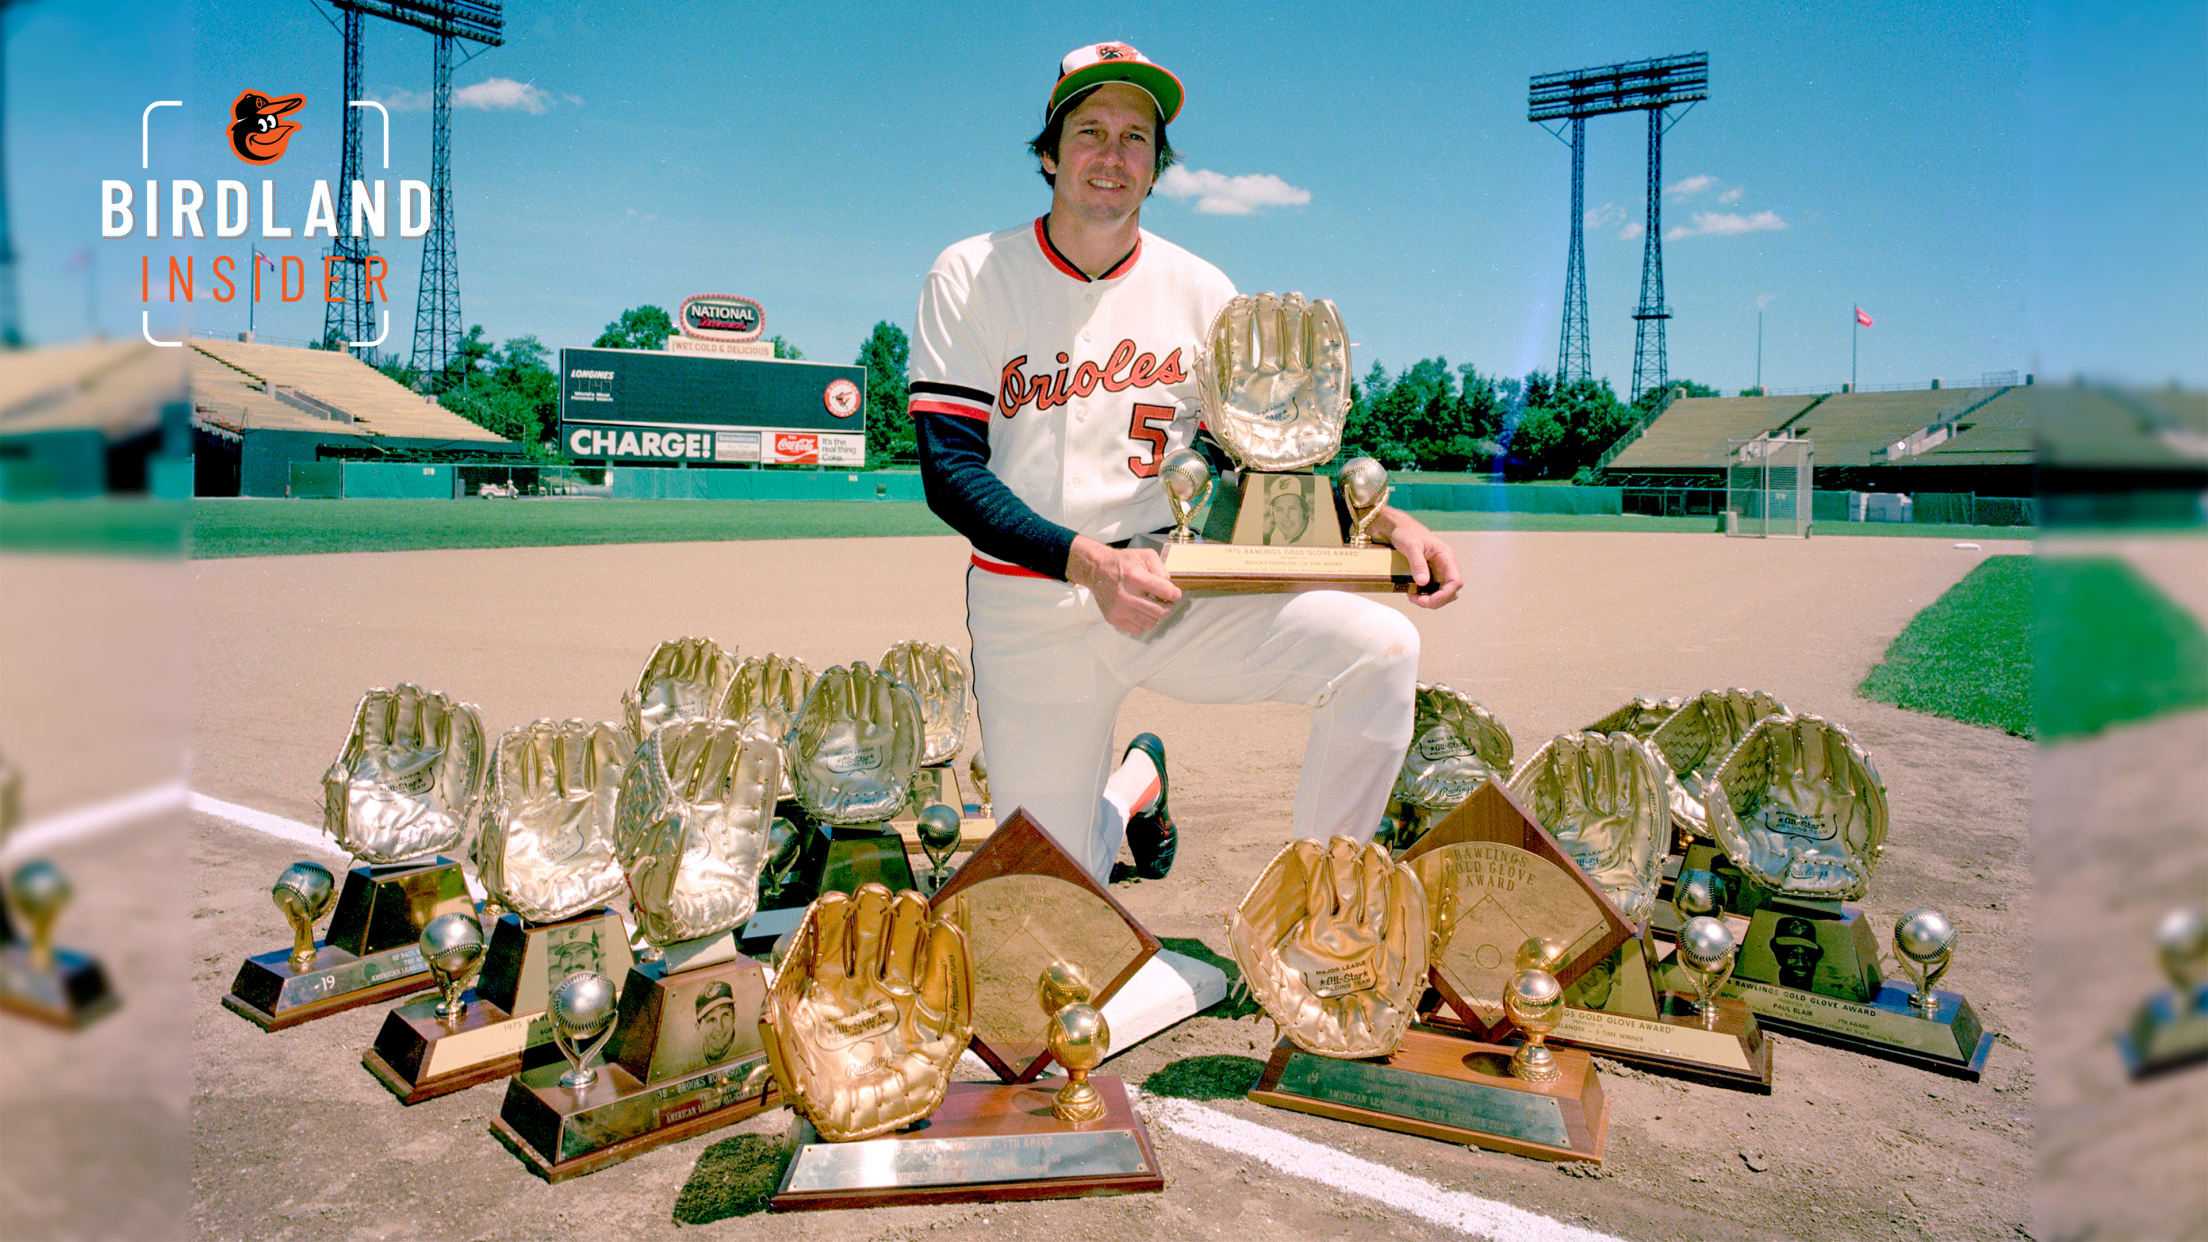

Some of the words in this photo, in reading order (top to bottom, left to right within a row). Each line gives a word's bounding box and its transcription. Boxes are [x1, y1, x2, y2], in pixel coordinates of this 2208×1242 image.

[691, 304, 755, 321] NATIONAL
[675, 342, 693, 351] WET
[694, 343, 718, 352] COLD
[727, 345, 769, 356] DELICIOUS
[570, 369, 615, 380] LONGINES
[998, 338, 1188, 419] Orioles
[569, 428, 711, 459] CHARGE!
[822, 437, 833, 446] It's
[834, 437, 847, 446] the
[1127, 402, 1176, 479] 5
[838, 446, 857, 455] thing
[1244, 548, 1282, 556] RAWLINGS
[1284, 549, 1305, 557] GOLD
[1307, 549, 1331, 557] GLOVE
[1333, 549, 1359, 558] AWARD
[1784, 816, 1819, 830] All-Star
[1454, 847, 1528, 868] RAWLINGS
[1445, 861, 1481, 875] GOLD
[1488, 862, 1536, 886] GLOVE
[1466, 874, 1515, 892] AWARD
[1316, 967, 1340, 975] MAJOR
[1341, 960, 1367, 971] LEAGUE
[320, 975, 336, 991] 19
[1326, 971, 1362, 986] All-Star
[1353, 978, 1371, 986] TEAM
[1735, 979, 1779, 997] RAWLINGS
[1783, 990, 1806, 1002] GOLD
[1809, 996, 1839, 1009] GLOVE
[1842, 1004, 1877, 1017] AWARD
[1772, 1002, 1791, 1013] PAUL
[1793, 1006, 1813, 1017] BLAIR
[1579, 1011, 1603, 1023] GOLD
[1606, 1014, 1636, 1029] GLOVE
[1639, 1022, 1671, 1034] AWARD
[1602, 1030, 1617, 1038] TIME
[1619, 1033, 1645, 1043] WINNER
[677, 1076, 706, 1094] BROOKS
[666, 1106, 697, 1124] AMERICAN
